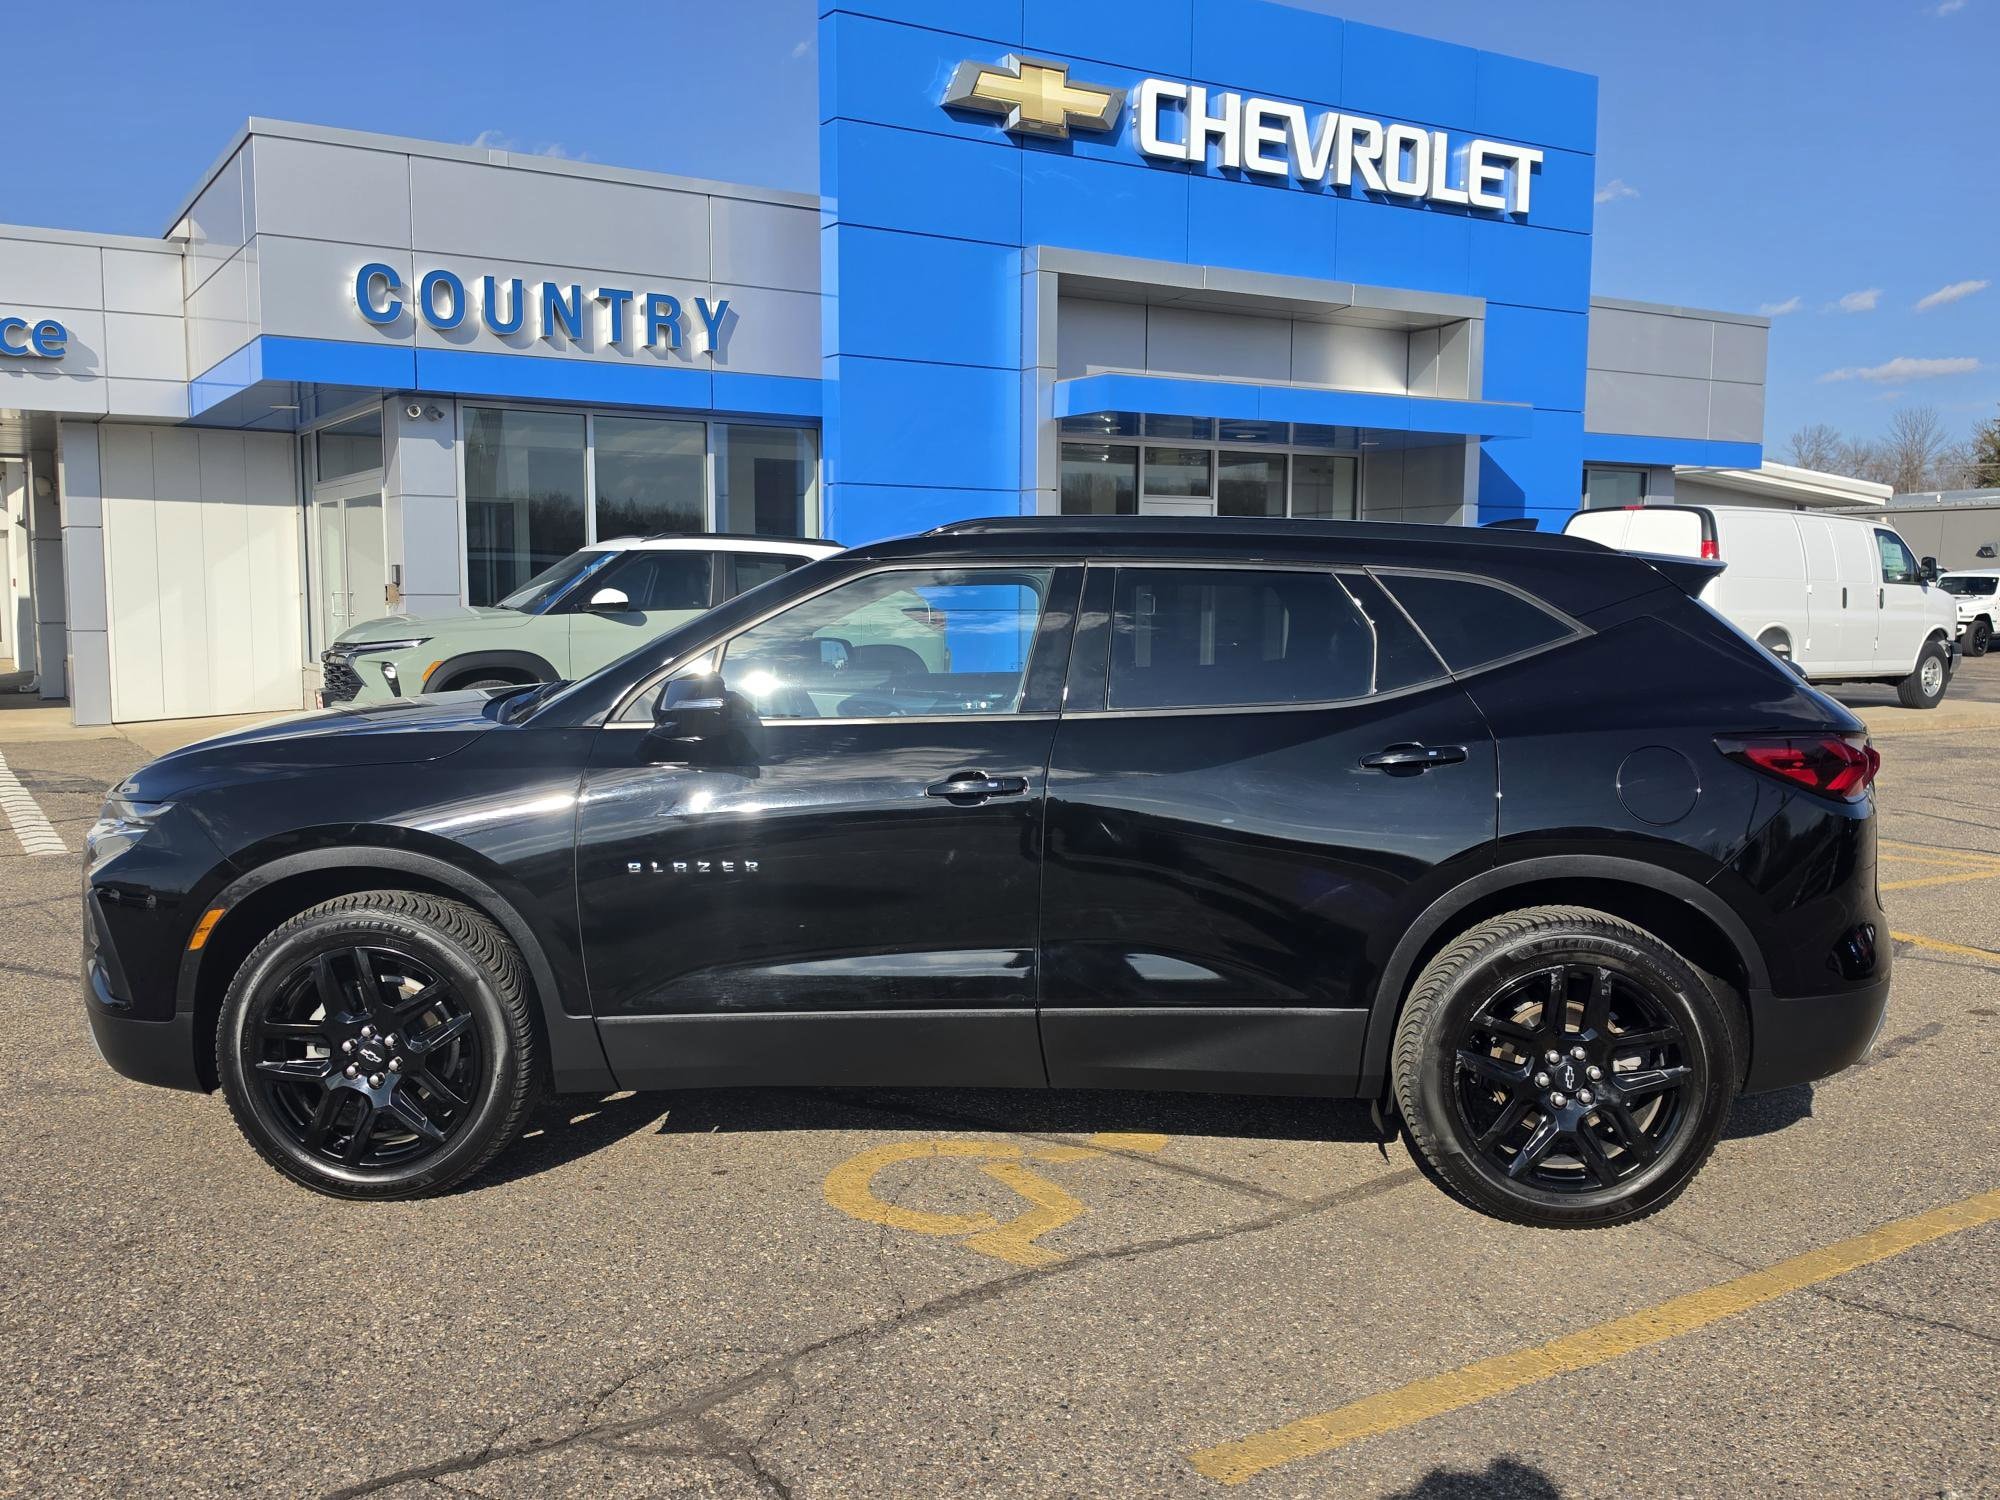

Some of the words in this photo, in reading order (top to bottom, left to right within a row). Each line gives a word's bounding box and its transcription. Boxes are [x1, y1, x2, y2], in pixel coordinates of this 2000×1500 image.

[1135, 78, 1543, 215] CHEVROLET
[355, 262, 730, 353] COUNTRY
[627, 860, 759, 873] BLAZER
